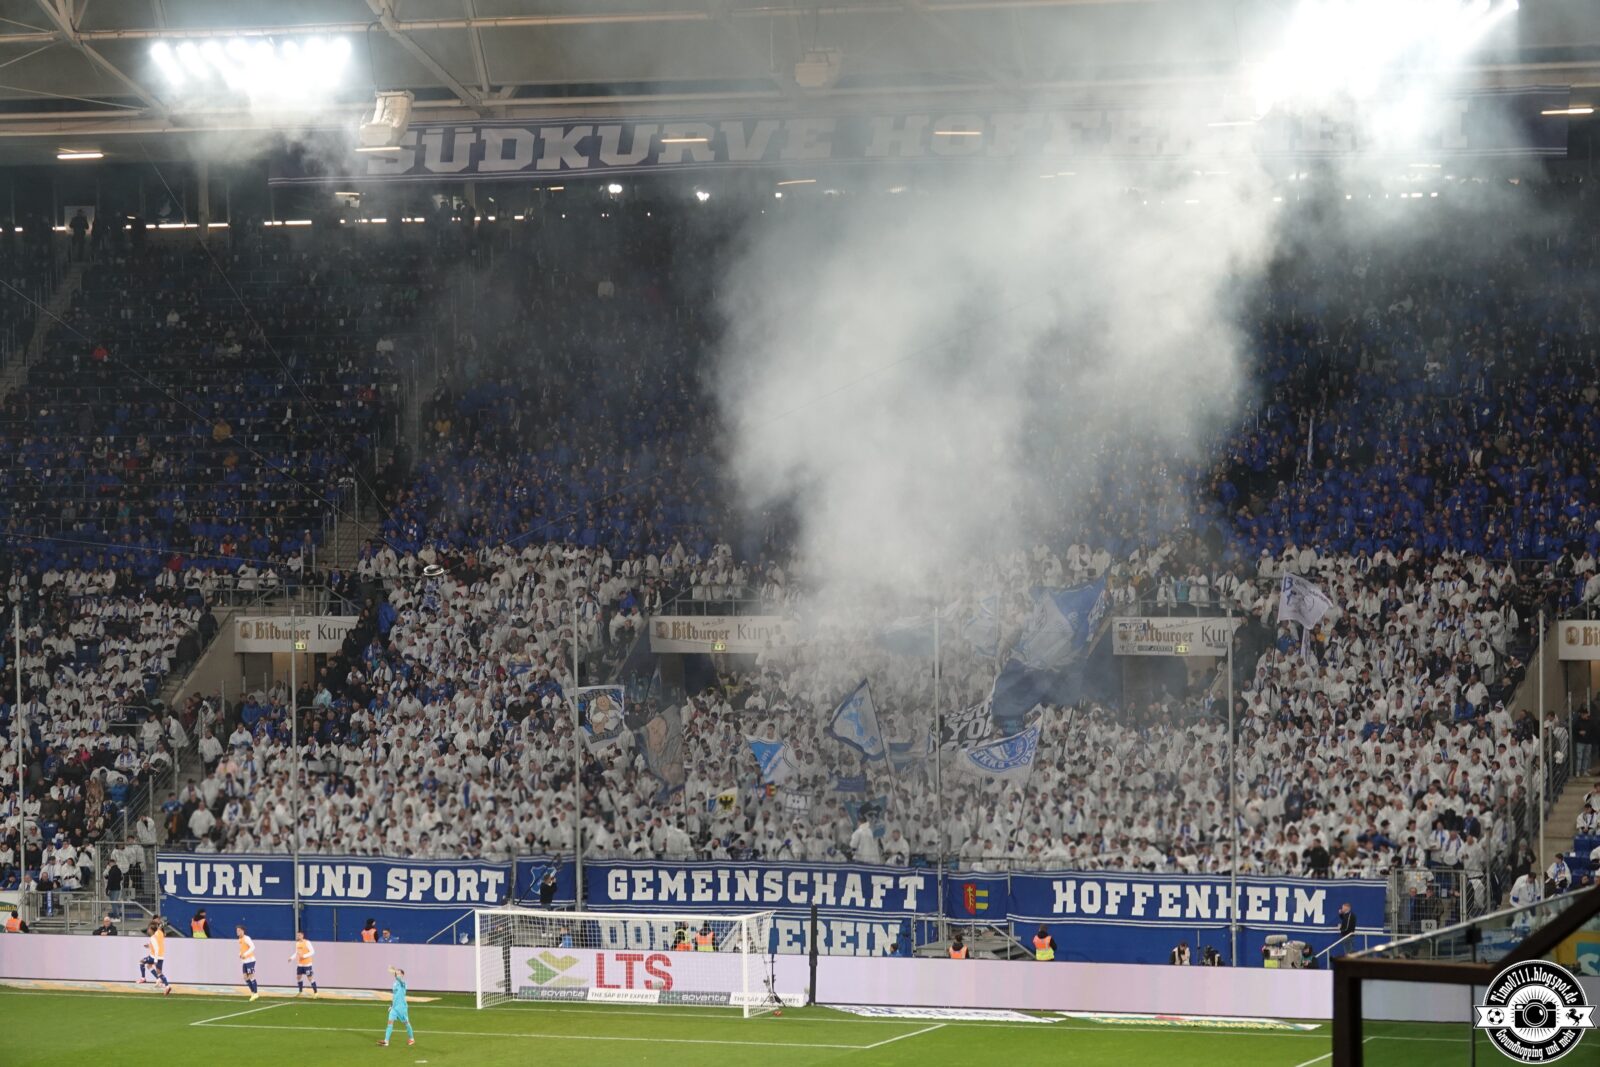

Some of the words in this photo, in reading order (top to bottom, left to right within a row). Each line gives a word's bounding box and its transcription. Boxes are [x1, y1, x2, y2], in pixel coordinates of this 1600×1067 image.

[367, 117, 833, 175] SÜDKURVE
[671, 620, 730, 642] Bitburger
[157, 861, 280, 896] TURN-
[298, 864, 373, 899] UND
[386, 868, 505, 902] SPORT
[607, 869, 925, 910] GEMEINSCHAFT
[1052, 880, 1327, 924] HOFFENHEIM
[596, 953, 673, 991] LTS
[540, 989, 586, 997] sovanta
[604, 991, 615, 999] SAP
[630, 992, 656, 1000] EXPERTS
[681, 994, 727, 1002] sovanta
